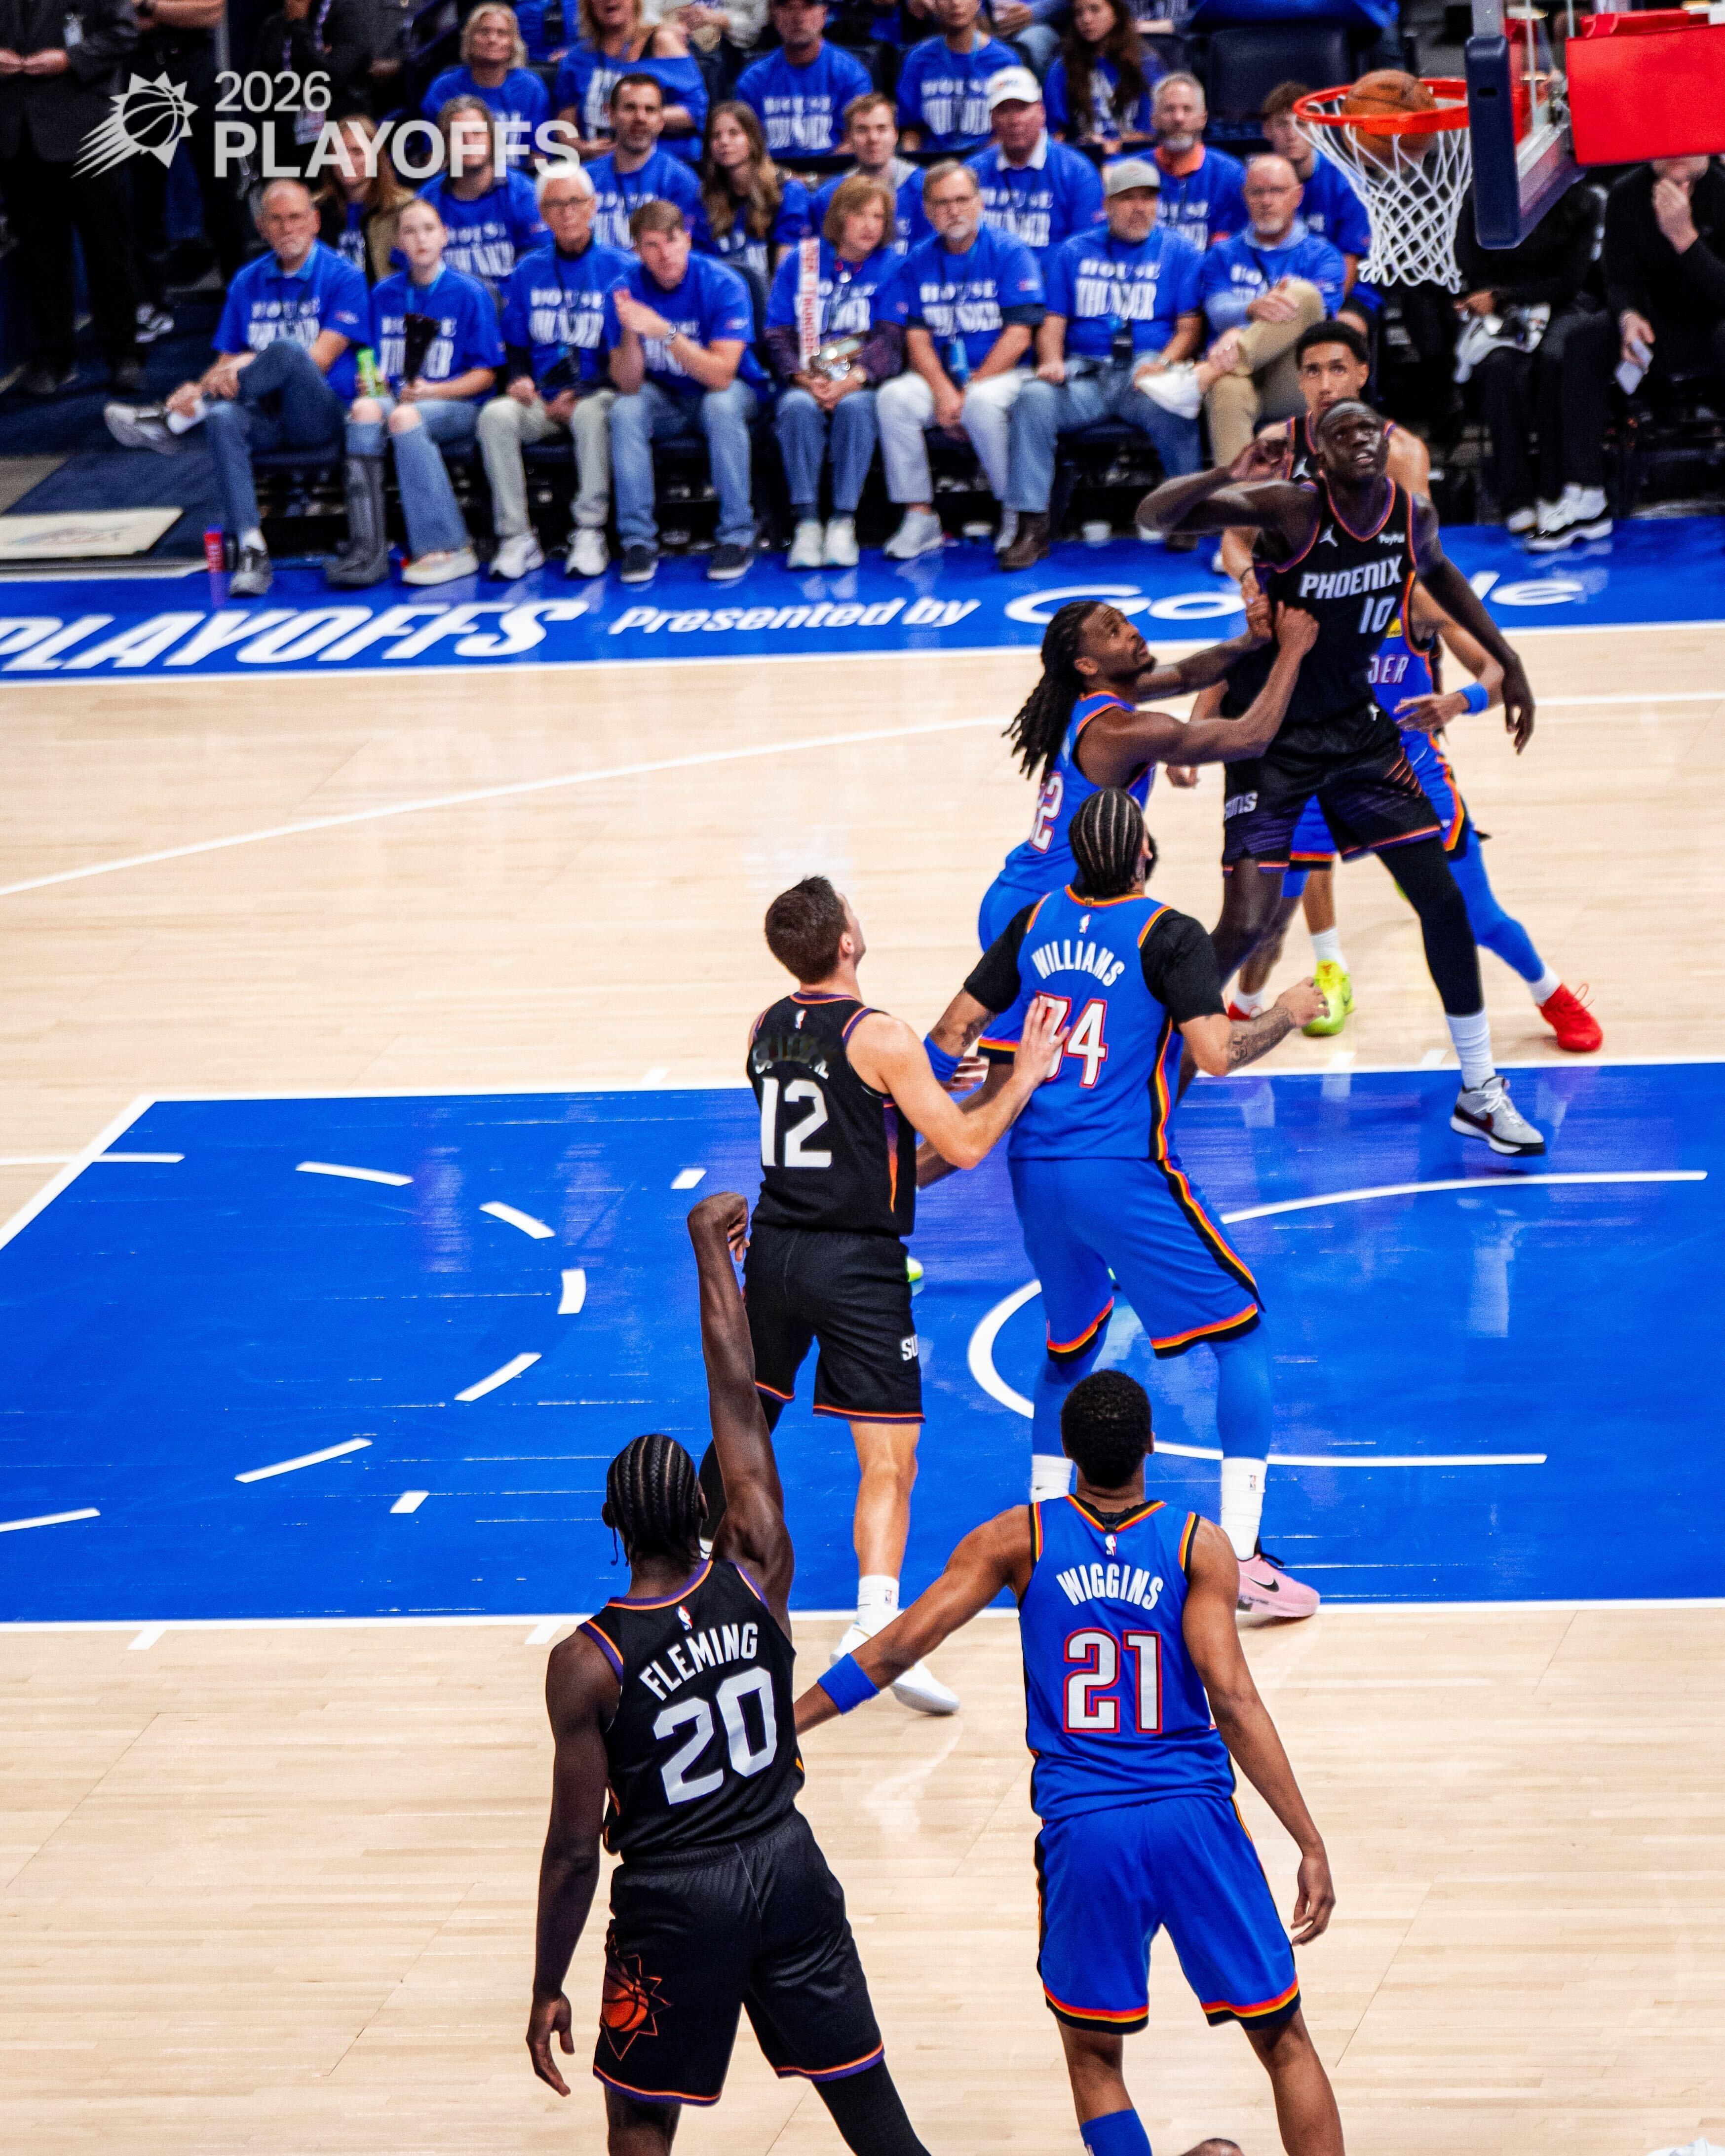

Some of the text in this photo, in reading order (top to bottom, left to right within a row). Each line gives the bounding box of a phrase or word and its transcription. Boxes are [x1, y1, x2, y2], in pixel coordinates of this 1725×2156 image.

[1004, 570, 1584, 624] Gole
[1298, 553, 1403, 600] PHOENIX
[0, 599, 589, 672] PLAYOFFS
[608, 595, 982, 635] Presented by
[1359, 594, 1396, 634] 10
[1029, 771, 1064, 854] 2
[1031, 939, 1125, 986] WILLIAMS
[761, 1076, 833, 1168] 12
[1056, 1562, 1164, 1610] WIGGINS
[639, 1623, 759, 1701] FLEMING
[1063, 1626, 1162, 1734] 21
[653, 1666, 778, 1806] 20
